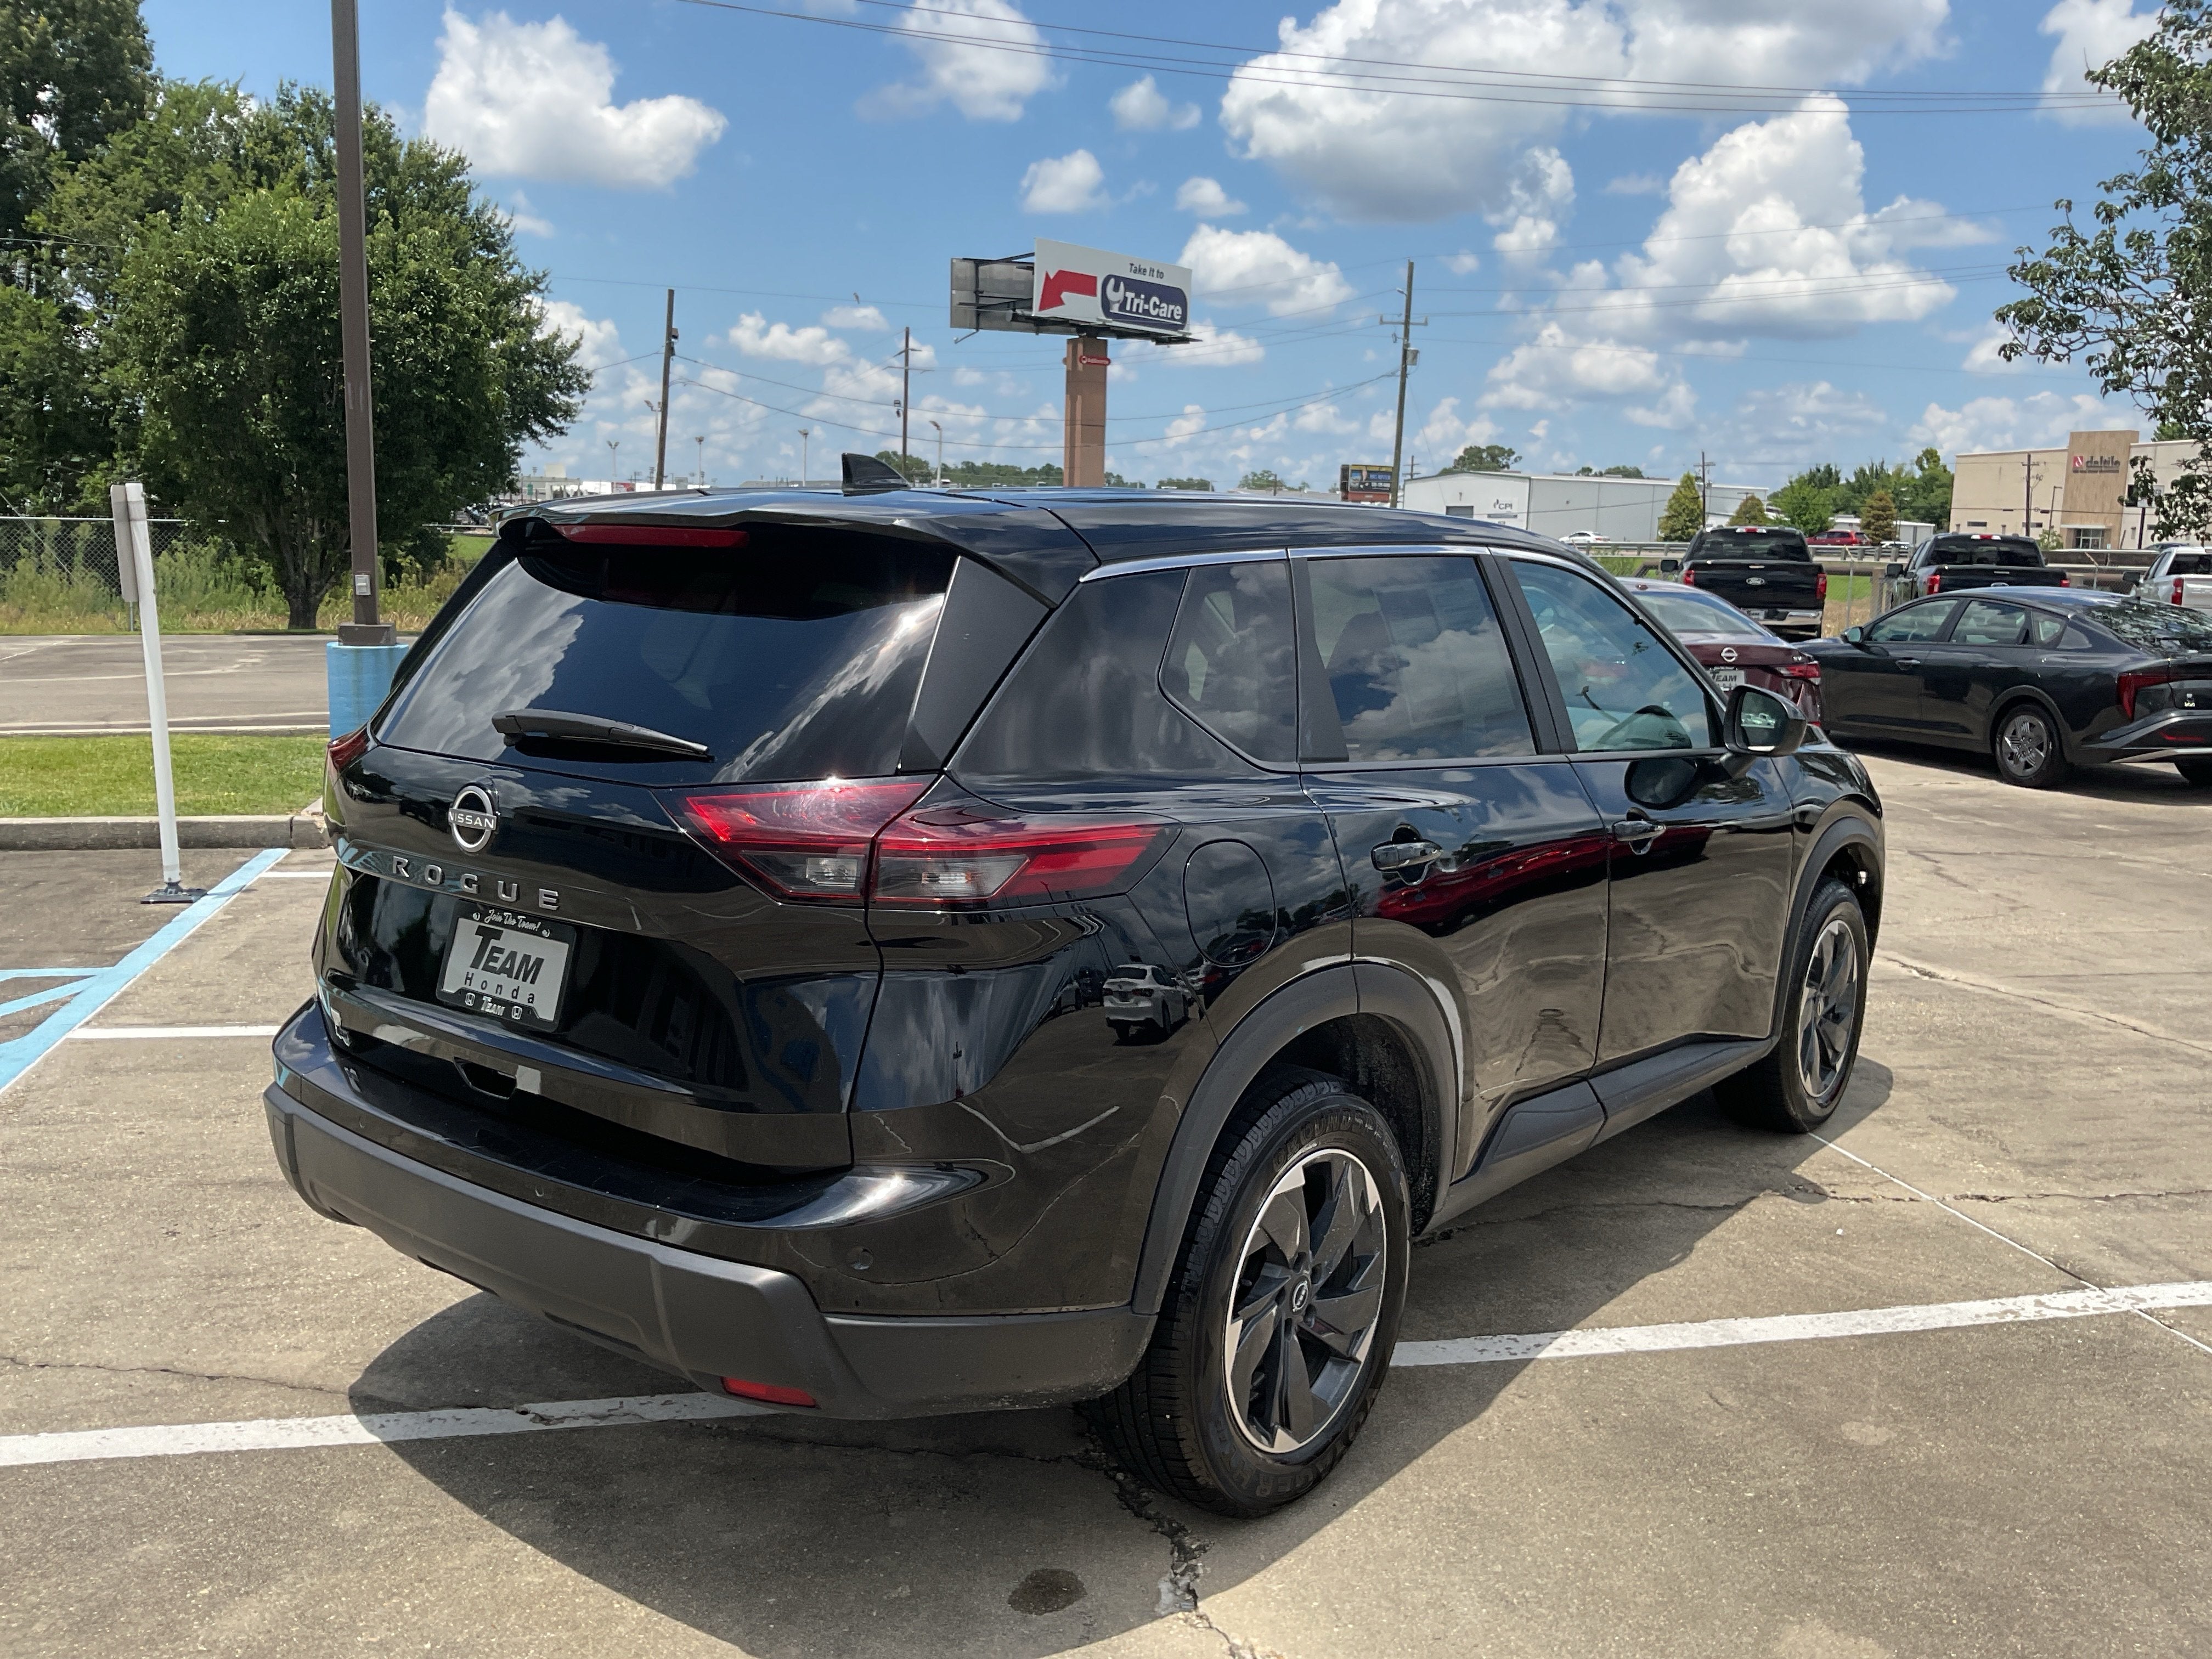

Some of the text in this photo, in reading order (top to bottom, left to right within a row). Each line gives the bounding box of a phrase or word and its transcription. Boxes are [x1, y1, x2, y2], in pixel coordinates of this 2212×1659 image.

[1129, 263, 1147, 276] Take
[1156, 269, 1164, 279] to
[1125, 291, 1182, 320] Tri-Care
[1710, 669, 1737, 682] TEAM
[448, 810, 494, 830] NISSAN
[392, 855, 560, 911] ROGUE
[484, 909, 541, 932] Join The Team!
[470, 925, 545, 985] TEAM
[465, 972, 535, 1004] Honda
[481, 996, 505, 1016] TEAM
